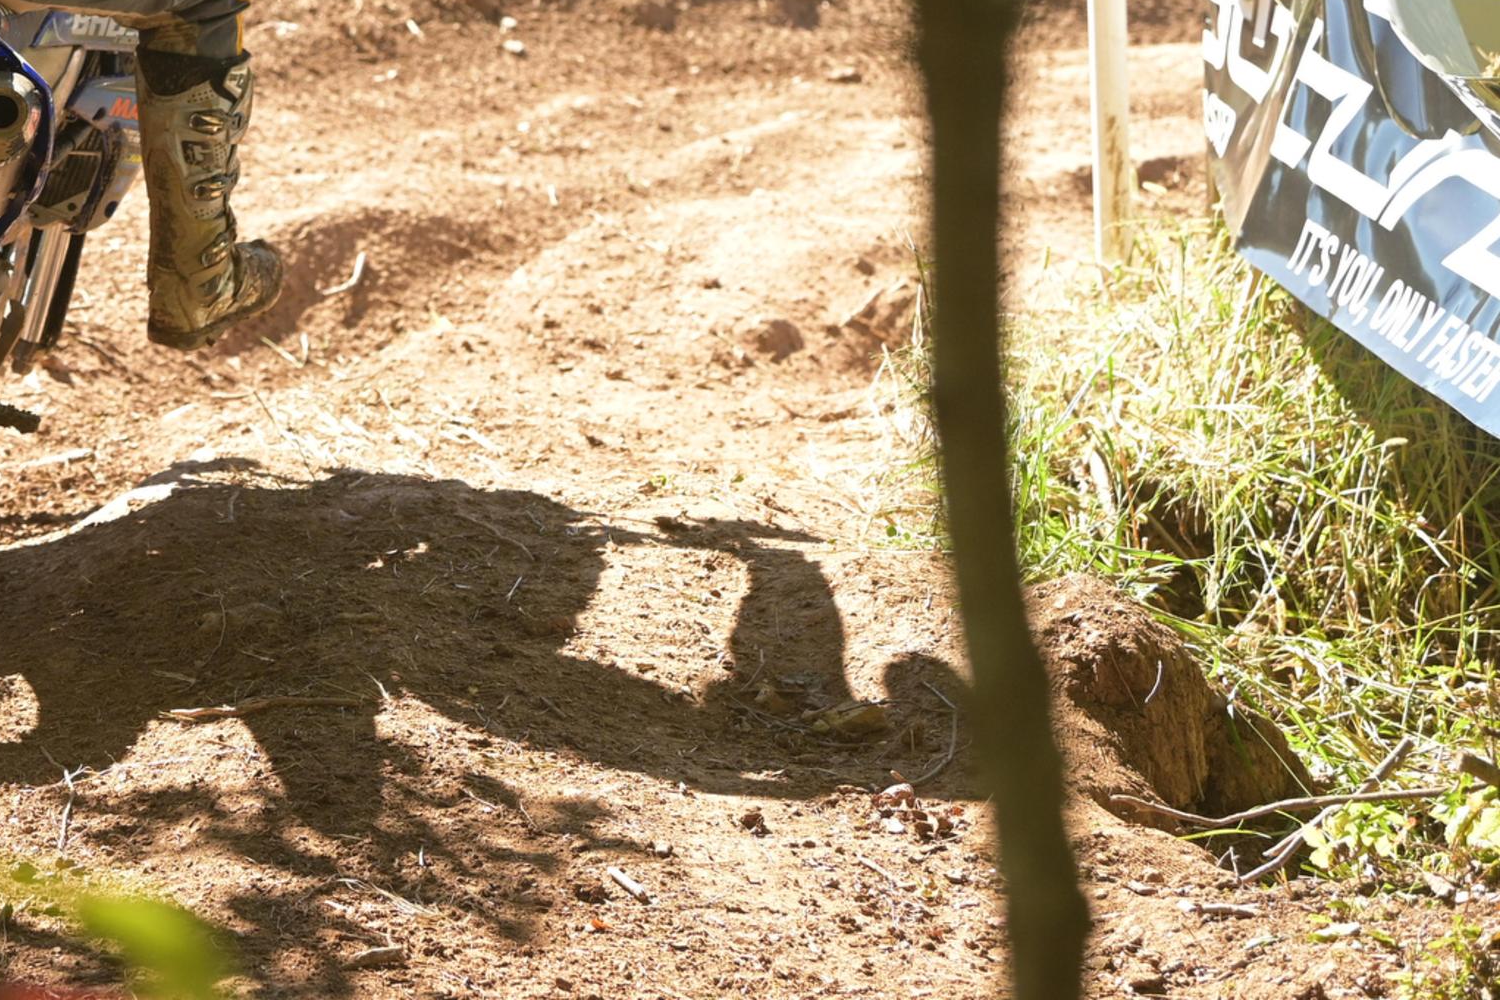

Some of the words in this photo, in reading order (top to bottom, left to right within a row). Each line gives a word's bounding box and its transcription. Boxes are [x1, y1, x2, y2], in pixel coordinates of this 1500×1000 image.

[1285, 217, 1340, 287] IT'S
[1326, 243, 1385, 327] YOU,
[1369, 278, 1446, 353] ONLY
